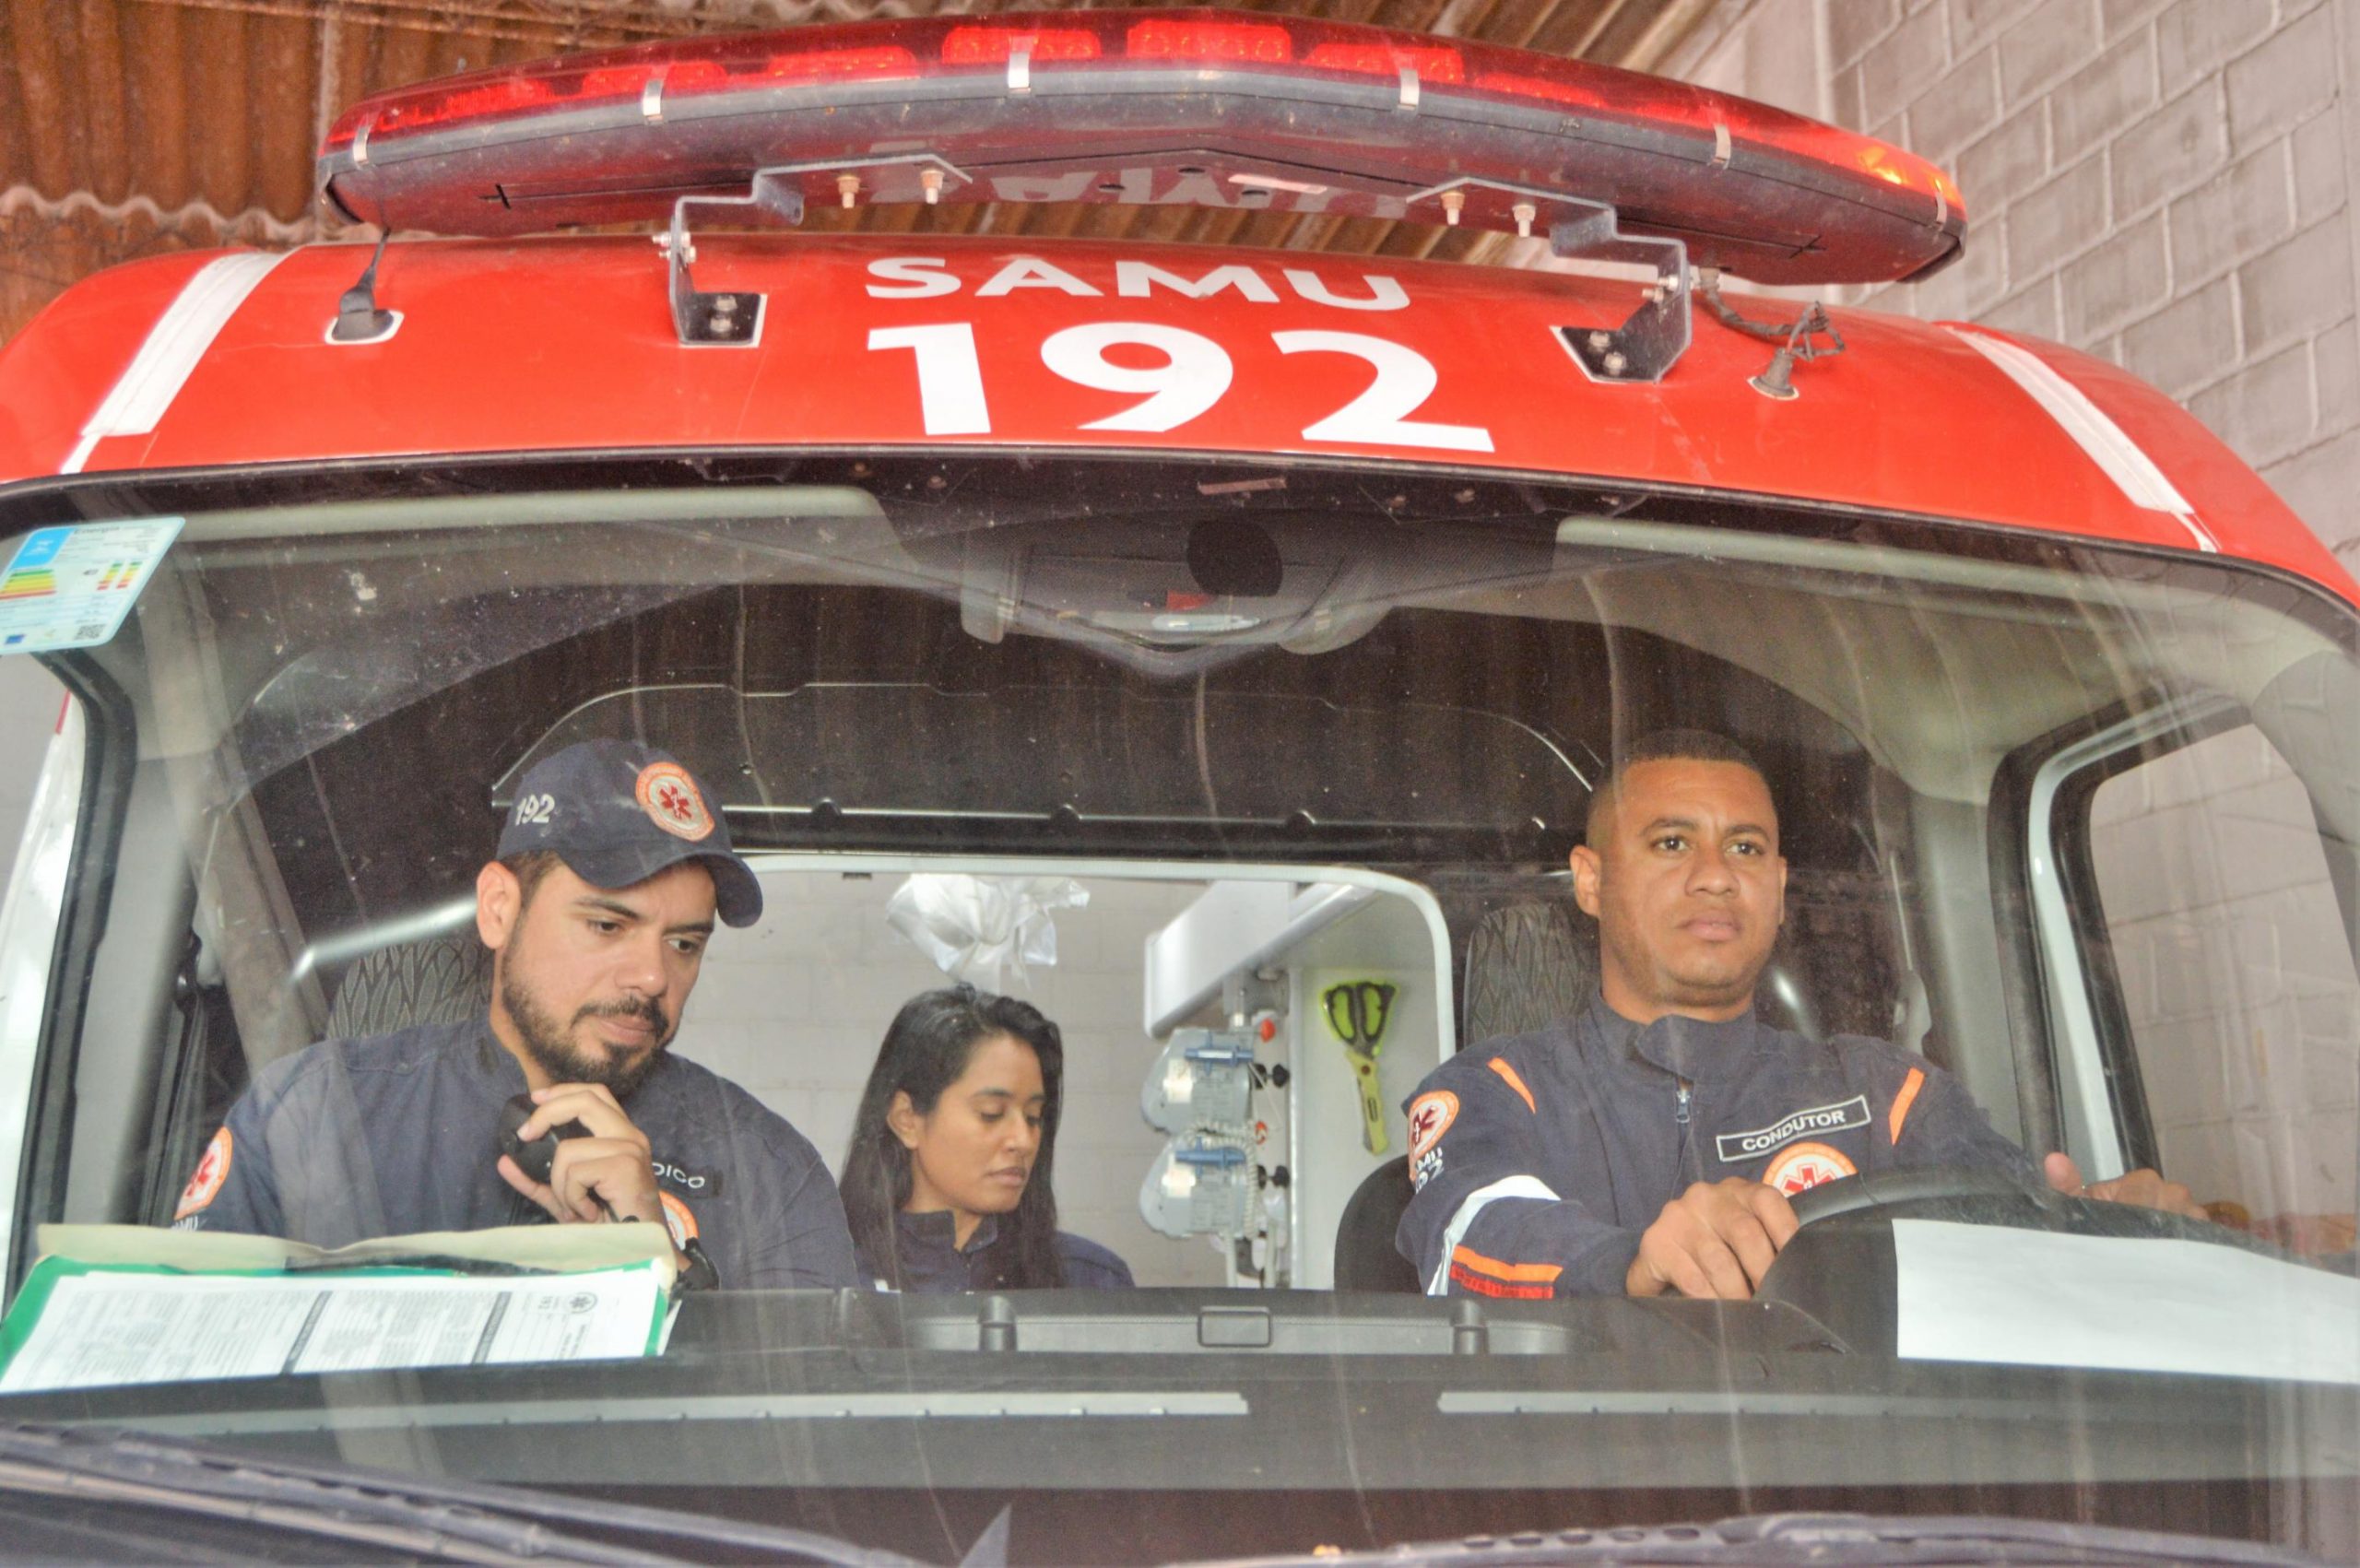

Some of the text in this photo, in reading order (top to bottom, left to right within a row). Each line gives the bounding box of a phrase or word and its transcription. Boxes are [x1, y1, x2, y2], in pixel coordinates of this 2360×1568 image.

[866, 256, 1410, 311] SAMU
[867, 322, 1495, 452] 192
[515, 794, 556, 827] 192
[1741, 1109, 1846, 1151] CONDUTOR
[651, 1161, 706, 1189] DICO
